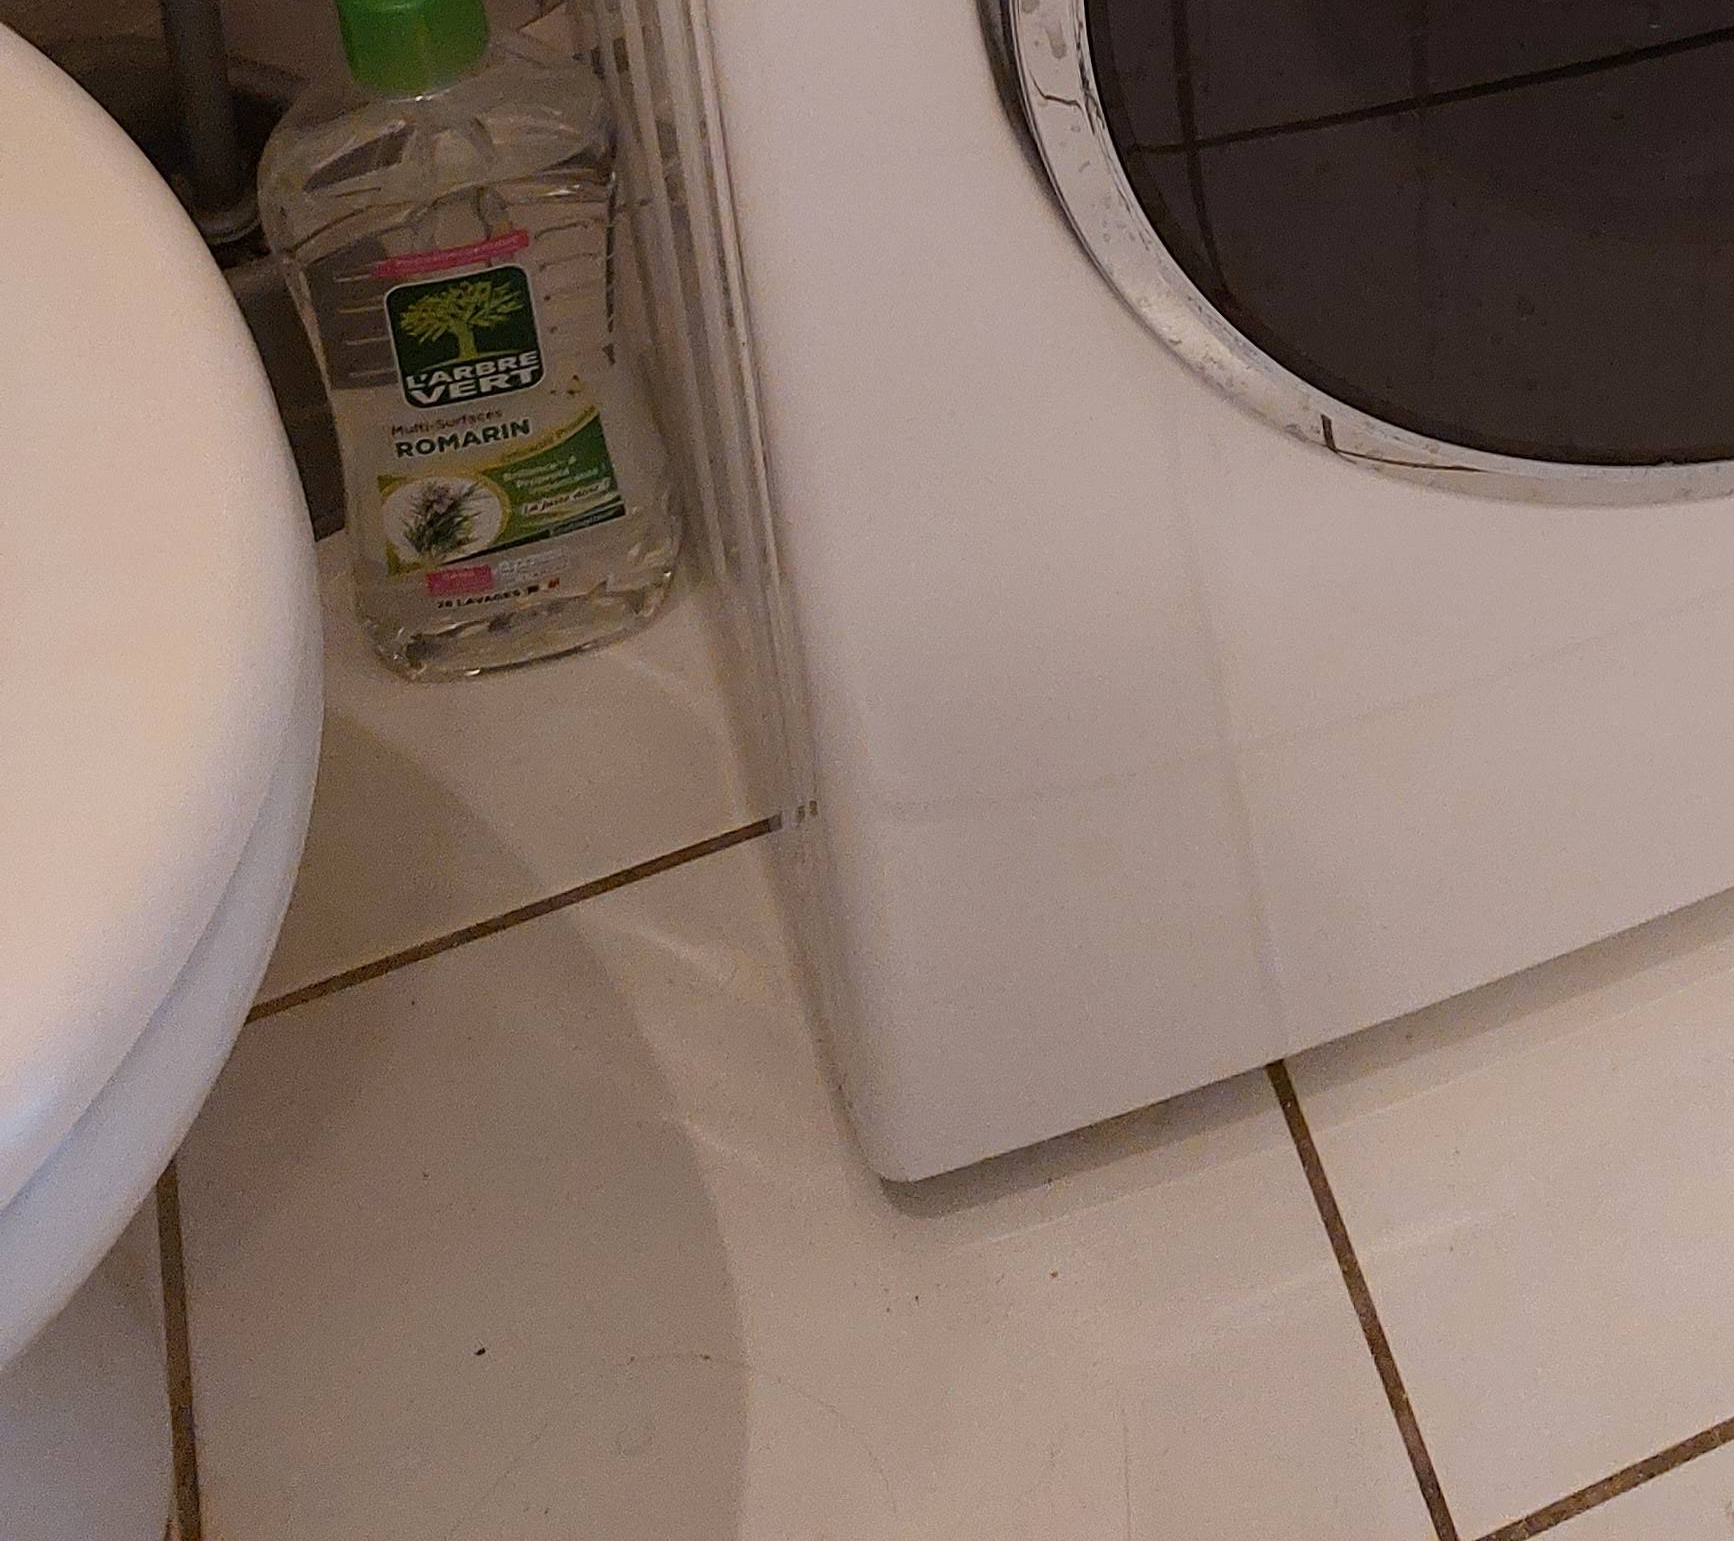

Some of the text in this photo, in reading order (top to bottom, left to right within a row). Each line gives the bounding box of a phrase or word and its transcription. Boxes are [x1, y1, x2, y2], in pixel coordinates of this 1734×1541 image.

[405, 349, 540, 390] L'ARBRE
[410, 365, 540, 405] VERT
[394, 418, 531, 459] ROMARIN
